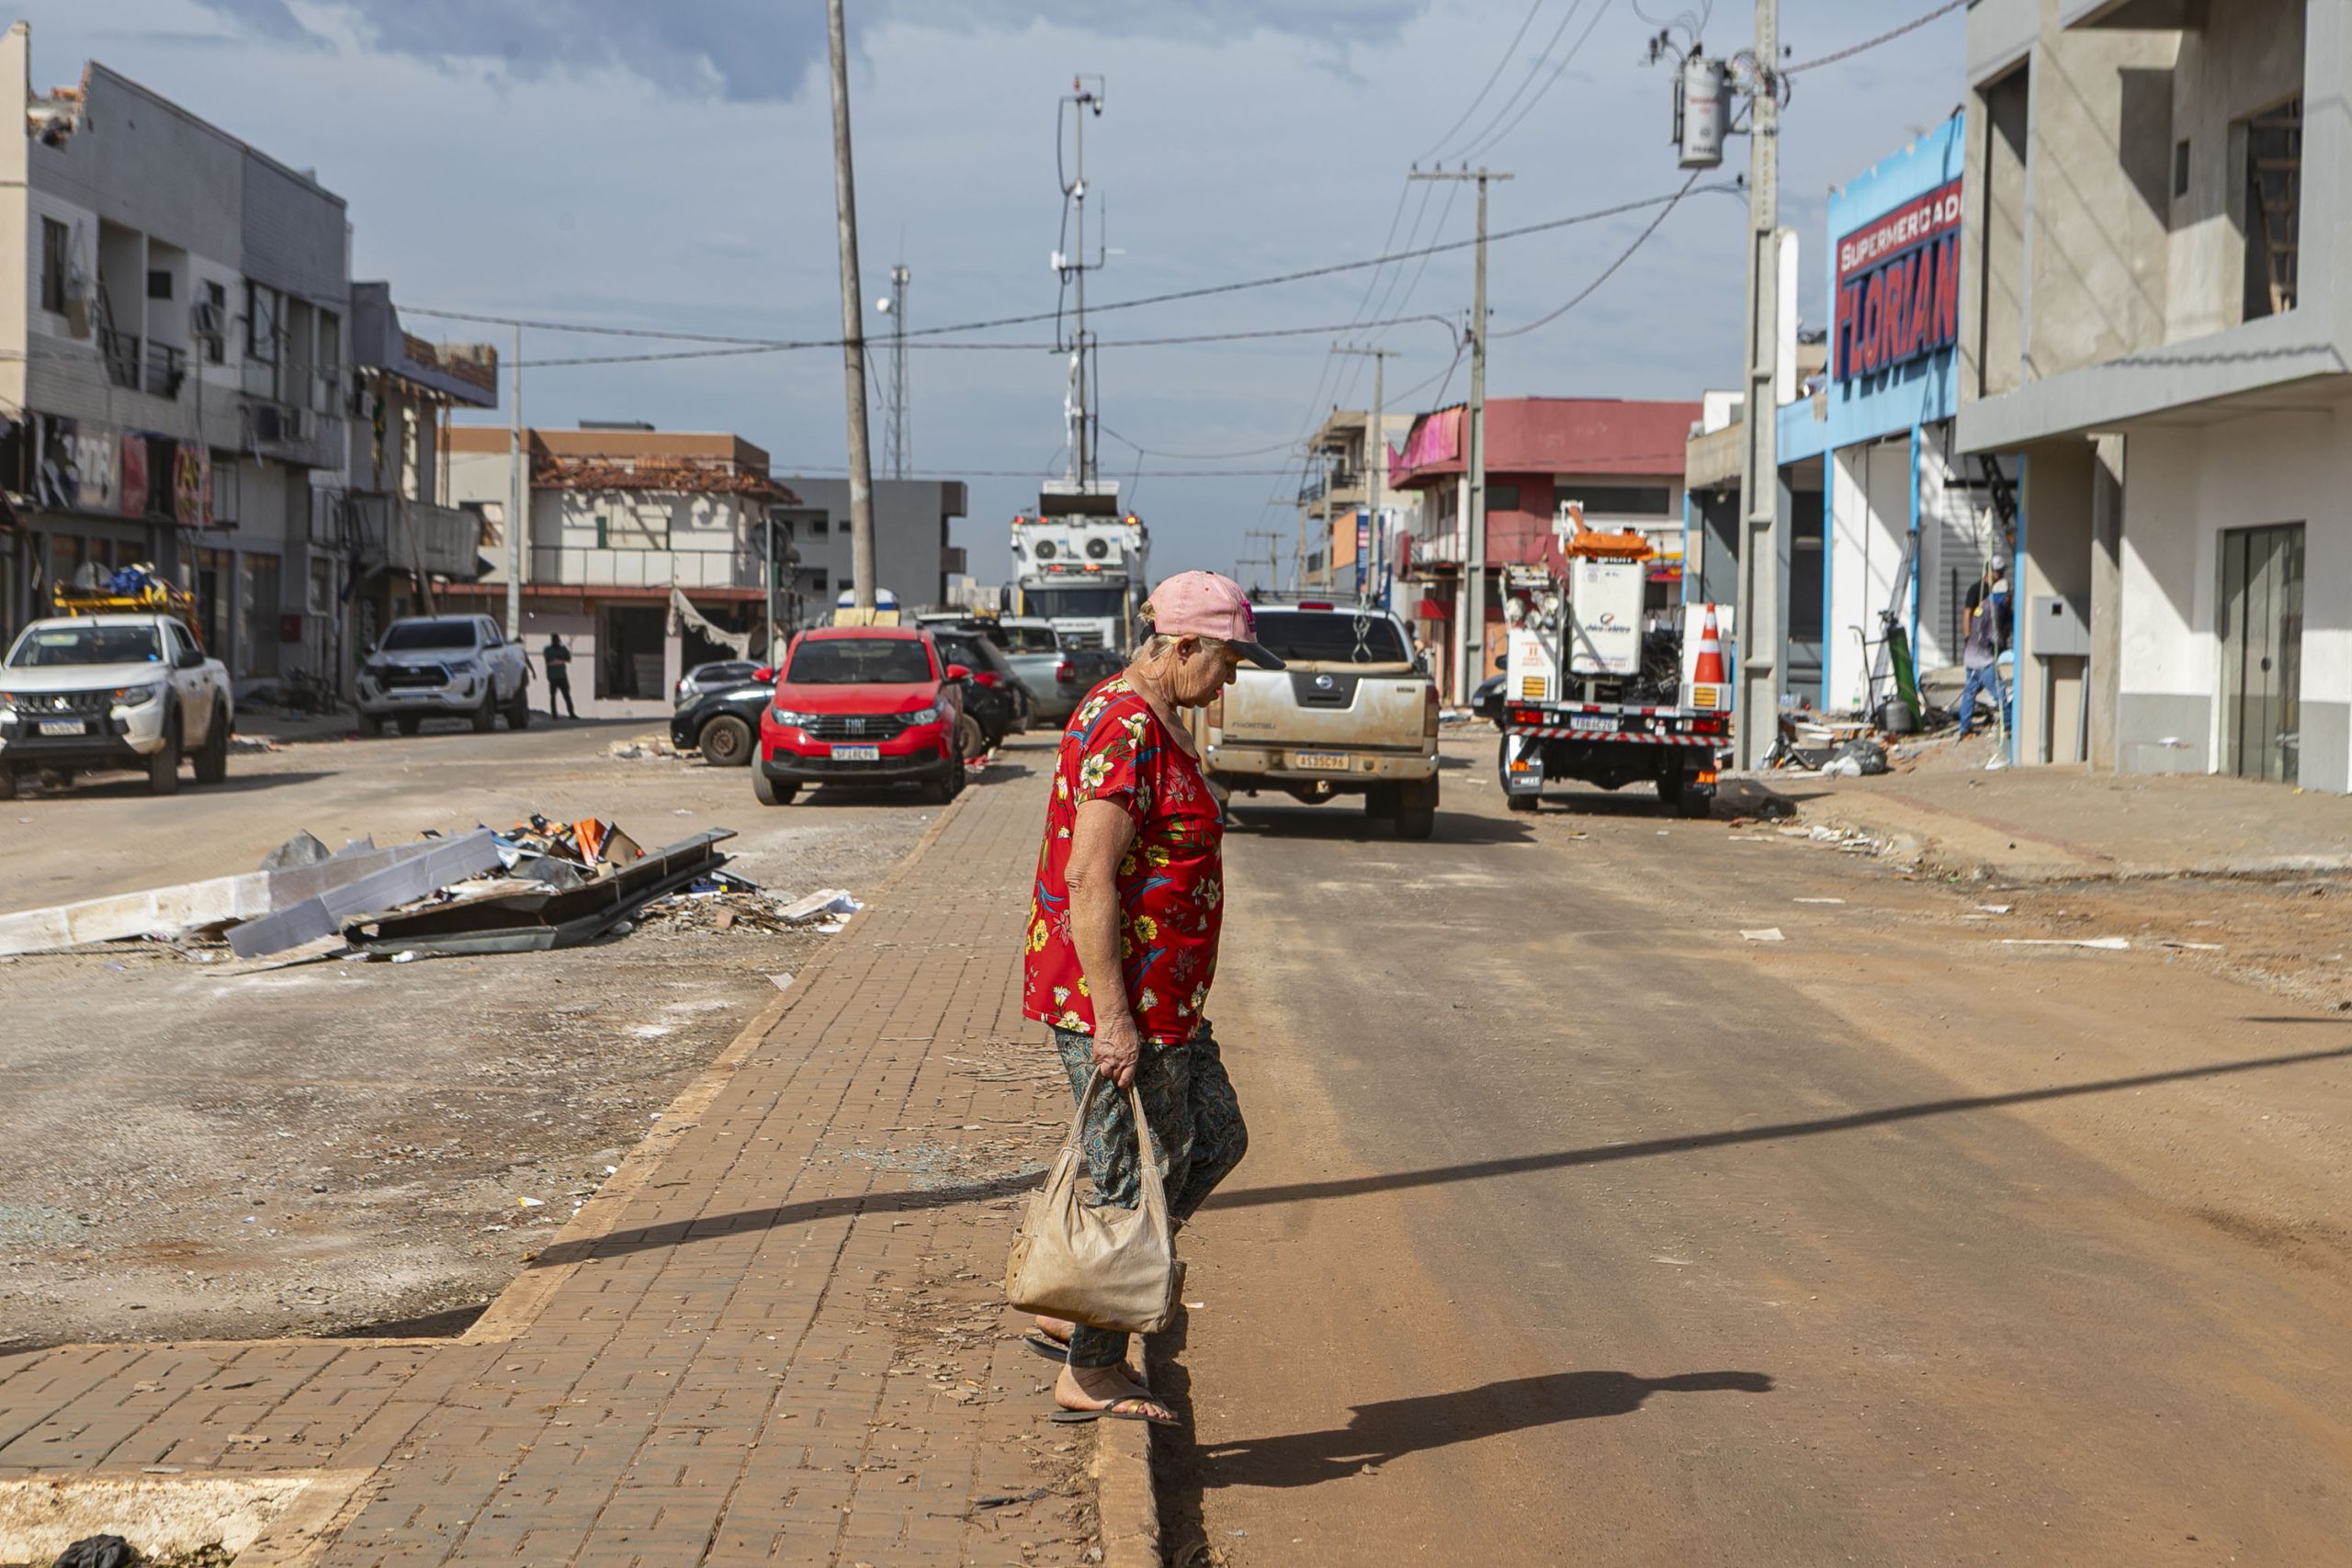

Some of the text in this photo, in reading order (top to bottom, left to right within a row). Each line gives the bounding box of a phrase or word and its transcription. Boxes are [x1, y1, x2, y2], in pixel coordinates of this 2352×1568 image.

[1840, 194, 1963, 272] SUPERMERCAD
[1834, 235, 1961, 381] FLORIAN
[845, 718, 866, 735] FIAT
